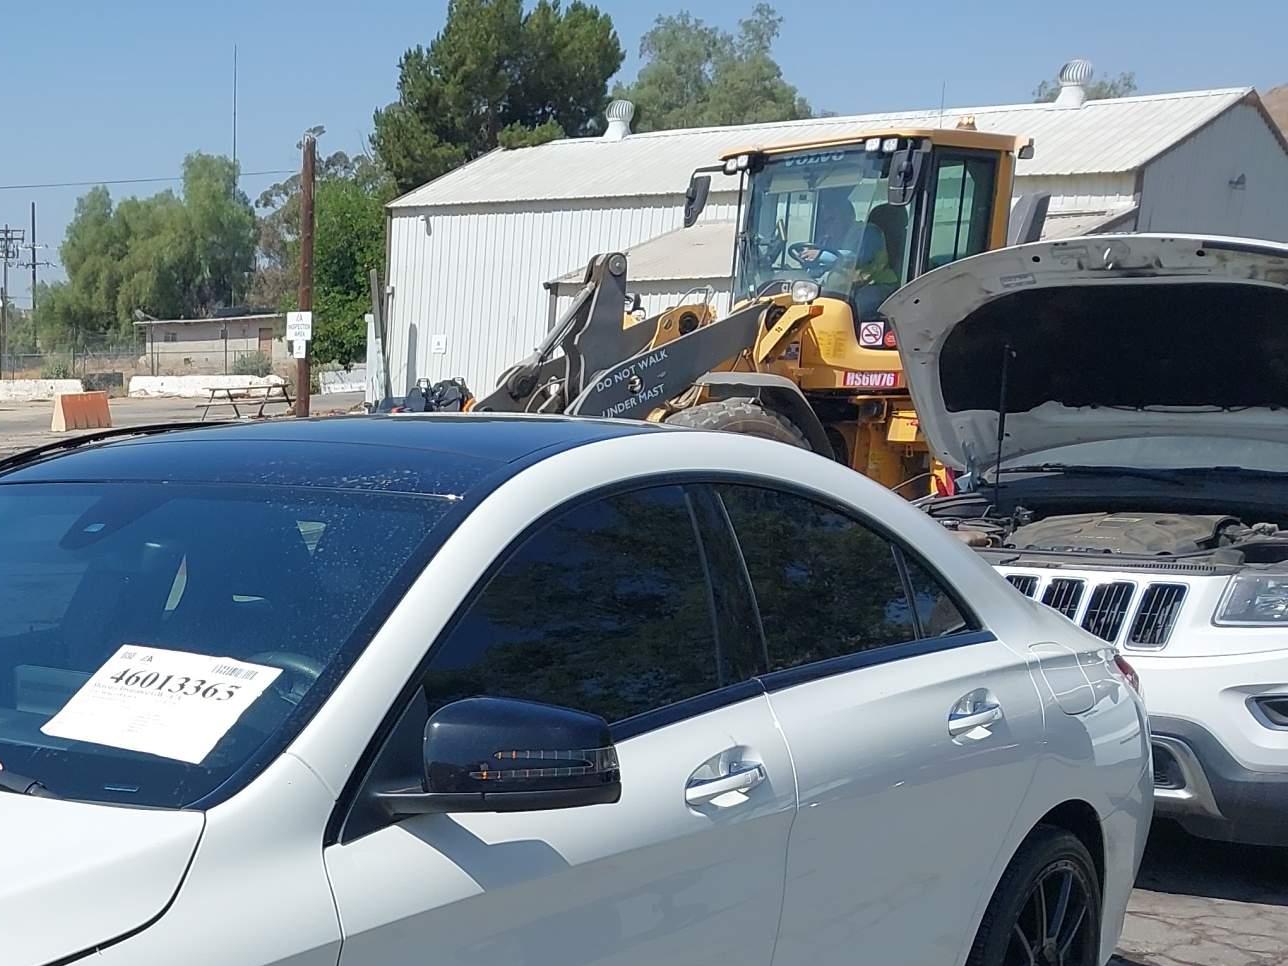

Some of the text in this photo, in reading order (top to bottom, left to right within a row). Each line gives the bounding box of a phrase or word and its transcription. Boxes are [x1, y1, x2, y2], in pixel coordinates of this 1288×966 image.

[596, 349, 669, 392] DO NOT WALK
[602, 383, 665, 418] UNDER MAST
[110, 668, 241, 702] 46013365
